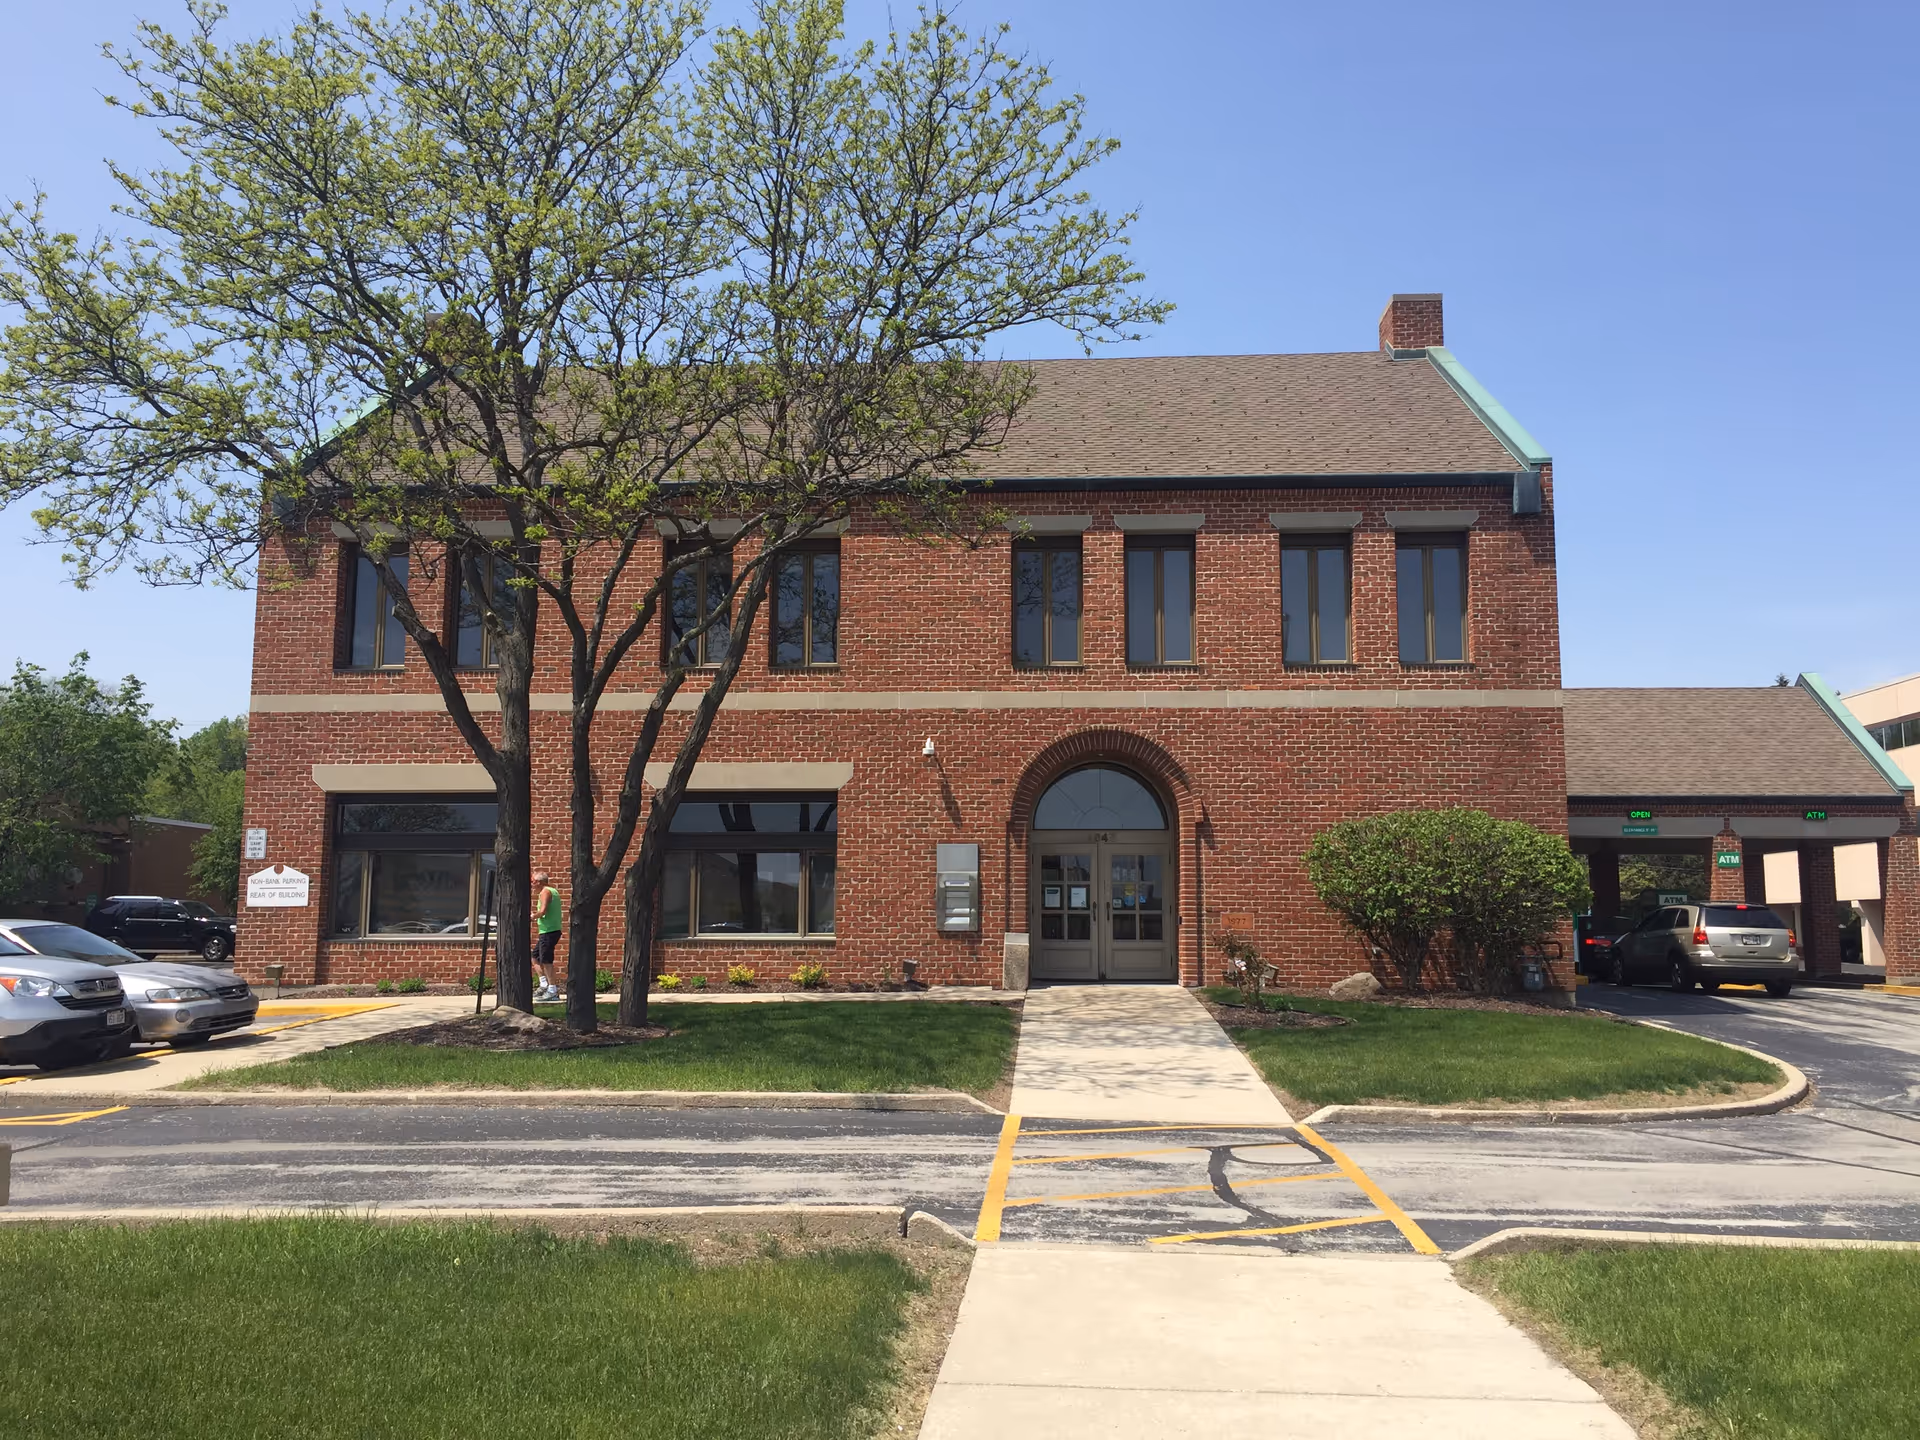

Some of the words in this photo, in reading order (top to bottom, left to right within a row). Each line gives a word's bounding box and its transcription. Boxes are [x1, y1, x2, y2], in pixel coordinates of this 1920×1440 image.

[1806, 811, 1825, 819] ATM
[1718, 855, 1739, 864] ATM
[1663, 896, 1684, 904] ATM
